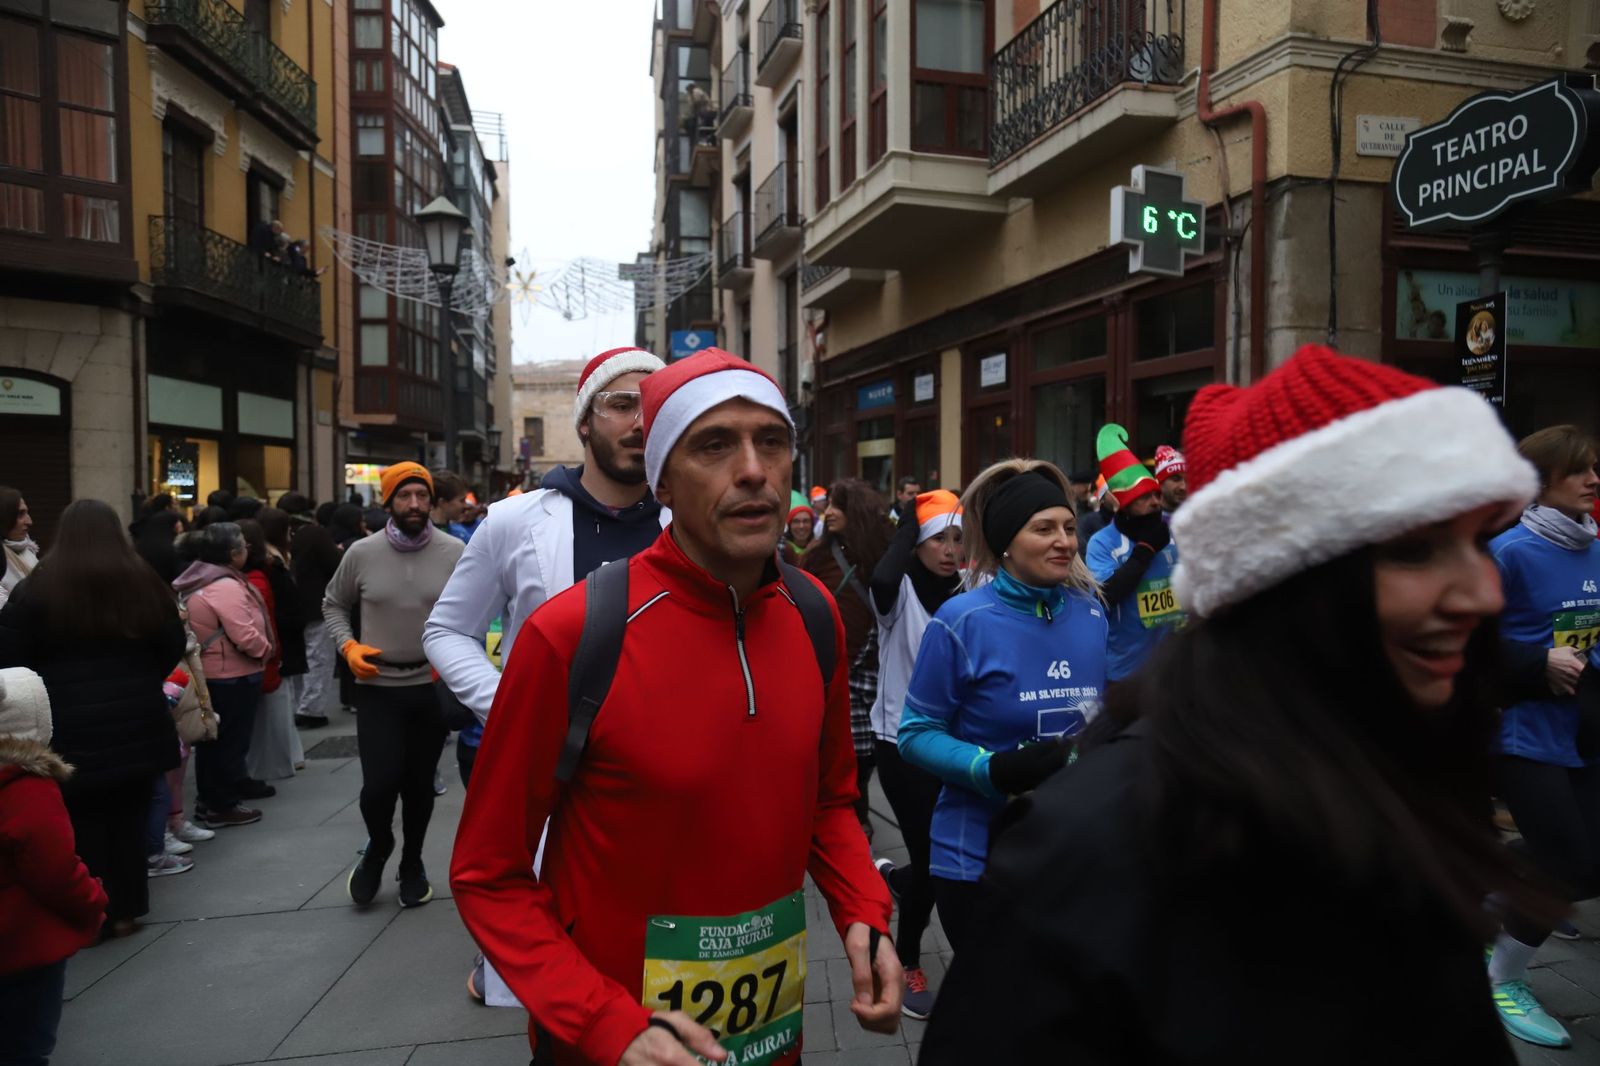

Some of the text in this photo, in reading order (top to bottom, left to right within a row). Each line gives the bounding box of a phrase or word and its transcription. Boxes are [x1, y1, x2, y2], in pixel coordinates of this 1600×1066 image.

[1379, 121, 1406, 131] CALLE
[1384, 133, 1395, 141] DE
[1432, 114, 1528, 166] TEATRO
[1419, 148, 1547, 207] PRINCIPAL
[1143, 205, 1158, 233] 6
[1437, 283, 1454, 297] Un
[1523, 286, 1559, 301] salud
[1142, 589, 1174, 613] 1206
[1047, 660, 1072, 680] 46
[1019, 689, 1037, 702] SAN
[1039, 687, 1081, 700] SILVESTRE
[699, 926, 774, 950] CAJA RURAL
[699, 948, 745, 959] DE ZAMORA
[658, 959, 788, 1040] 1287
[742, 1028, 795, 1063] RURAL
